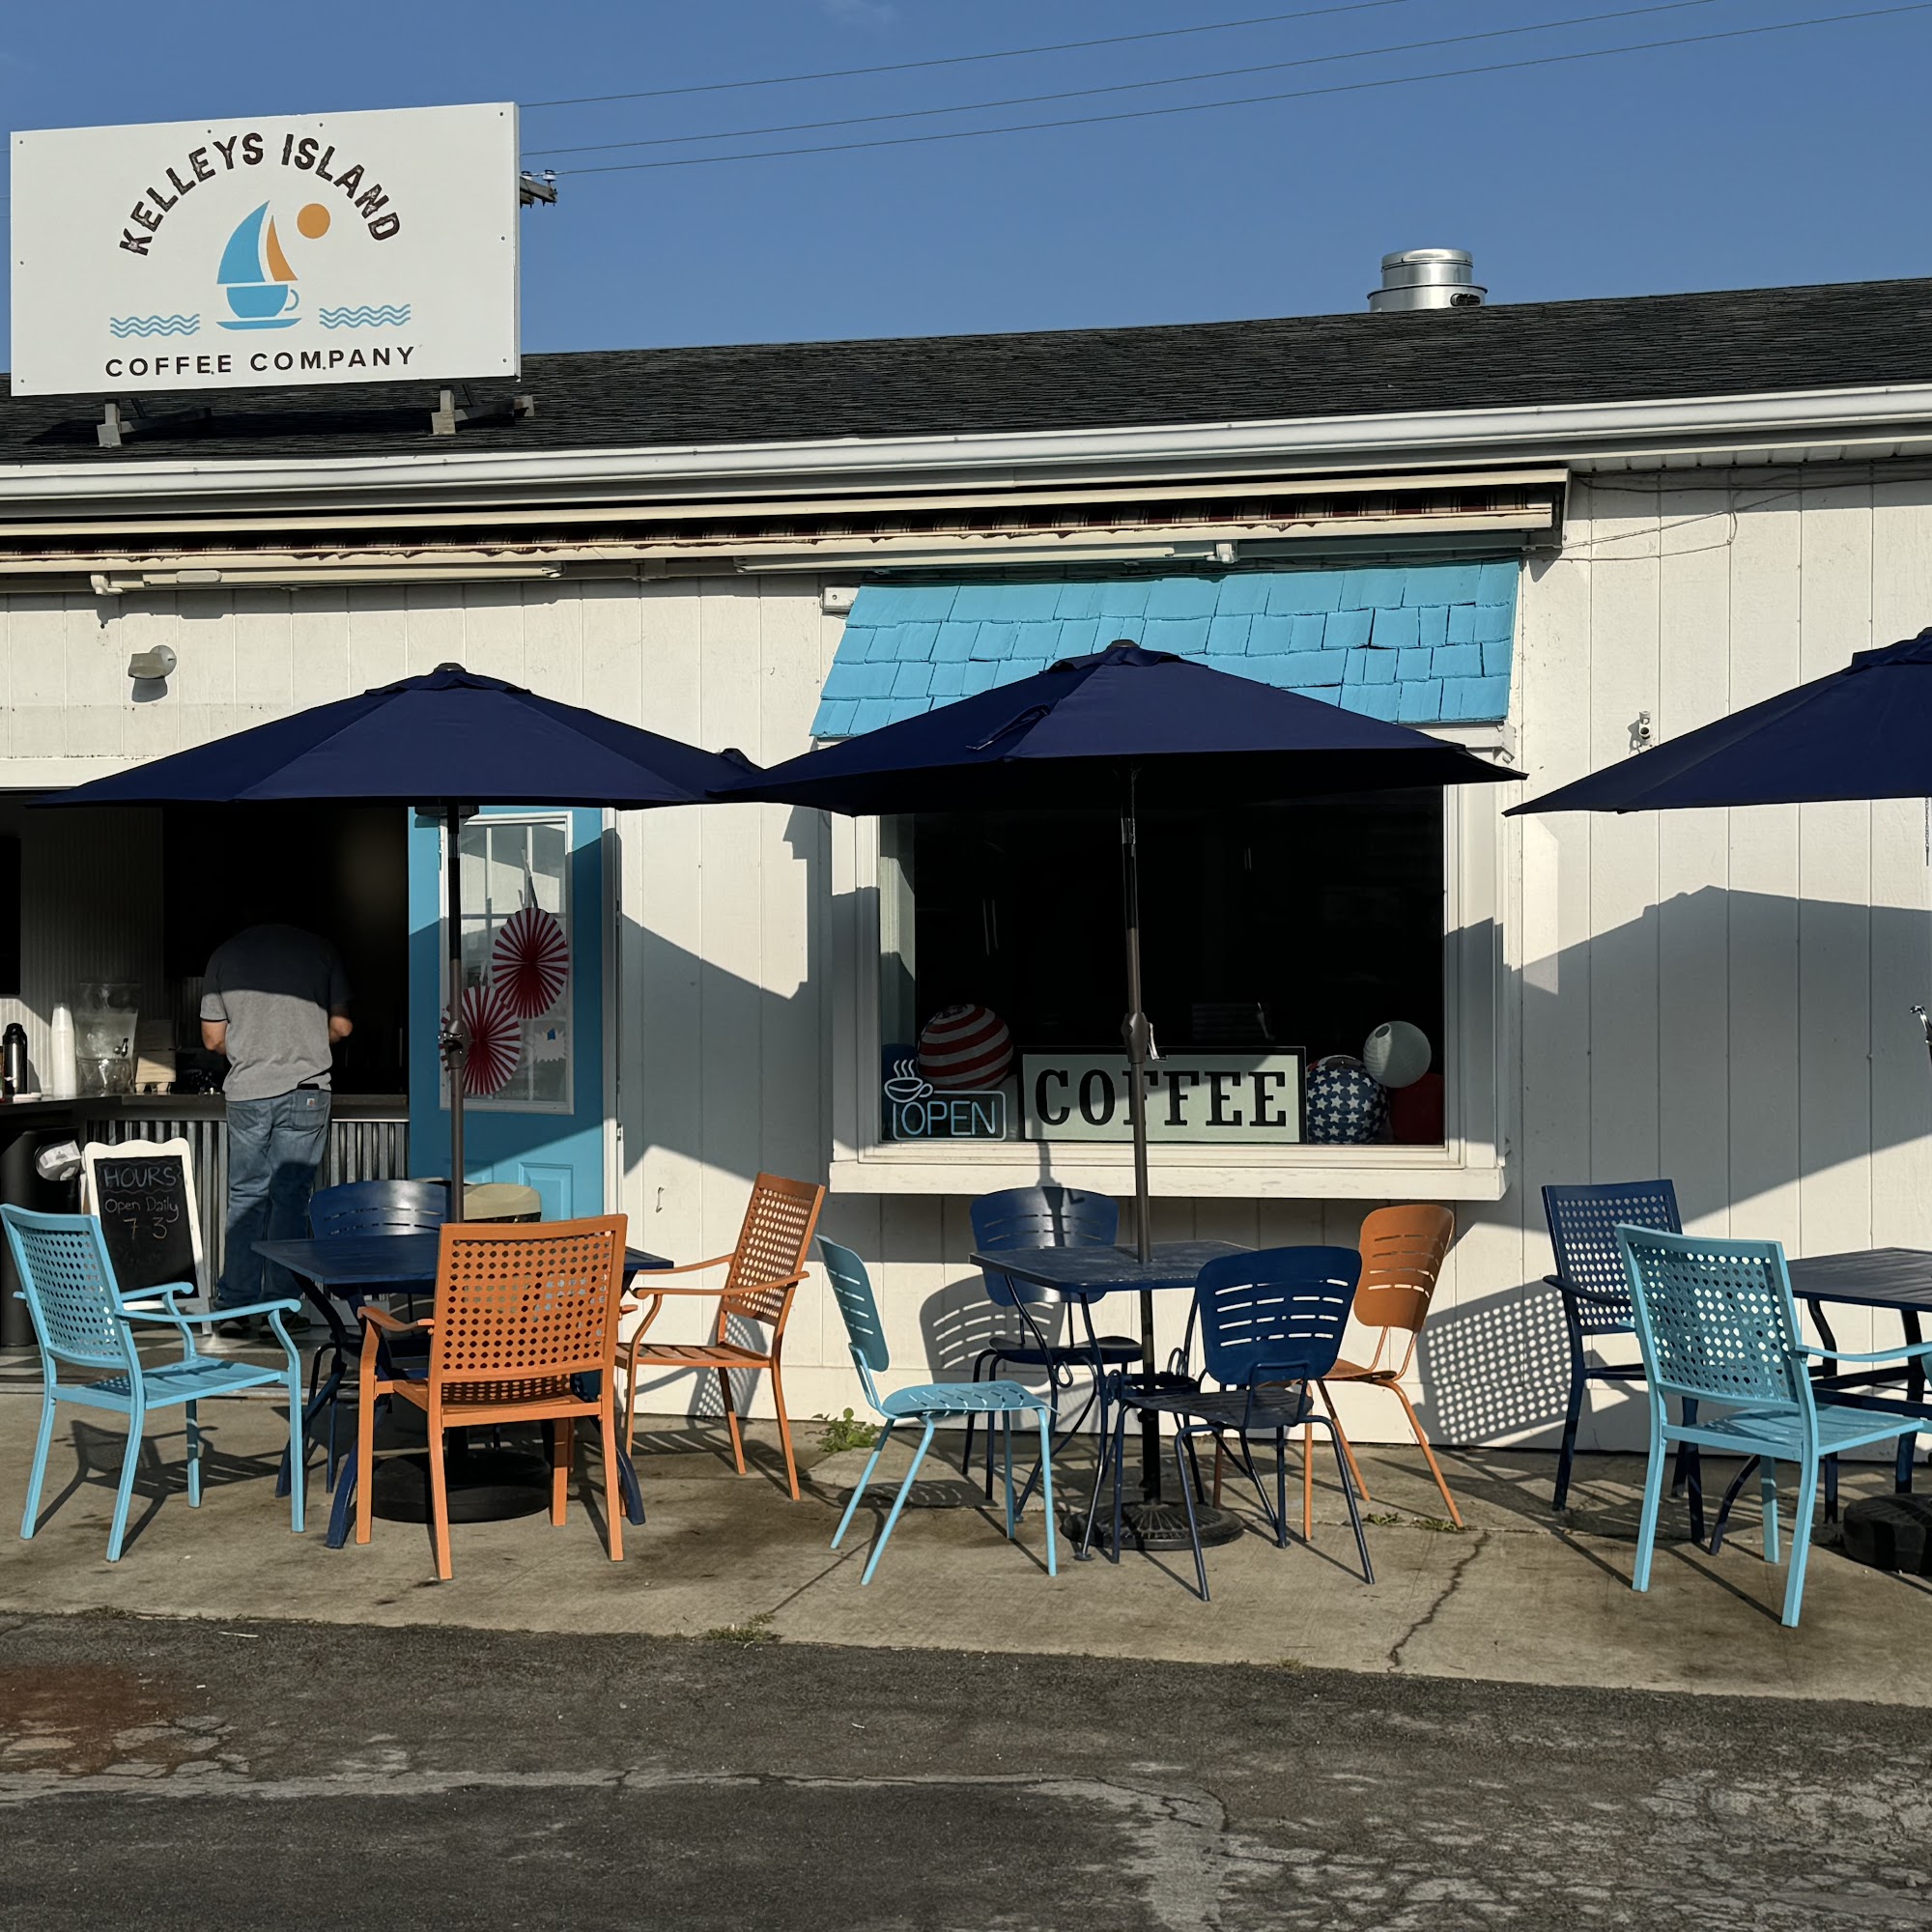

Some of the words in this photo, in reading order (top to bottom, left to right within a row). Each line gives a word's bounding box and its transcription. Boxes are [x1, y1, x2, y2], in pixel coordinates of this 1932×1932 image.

[119, 131, 264, 256] KELLEYS
[281, 133, 401, 242] ISLAND
[105, 354, 232, 378] COFFEE
[250, 346, 415, 372] COMPANY
[900, 1099, 996, 1137] OPEN
[104, 1166, 176, 1187] HOURS
[104, 1198, 141, 1214] Open
[145, 1196, 180, 1223] Daily
